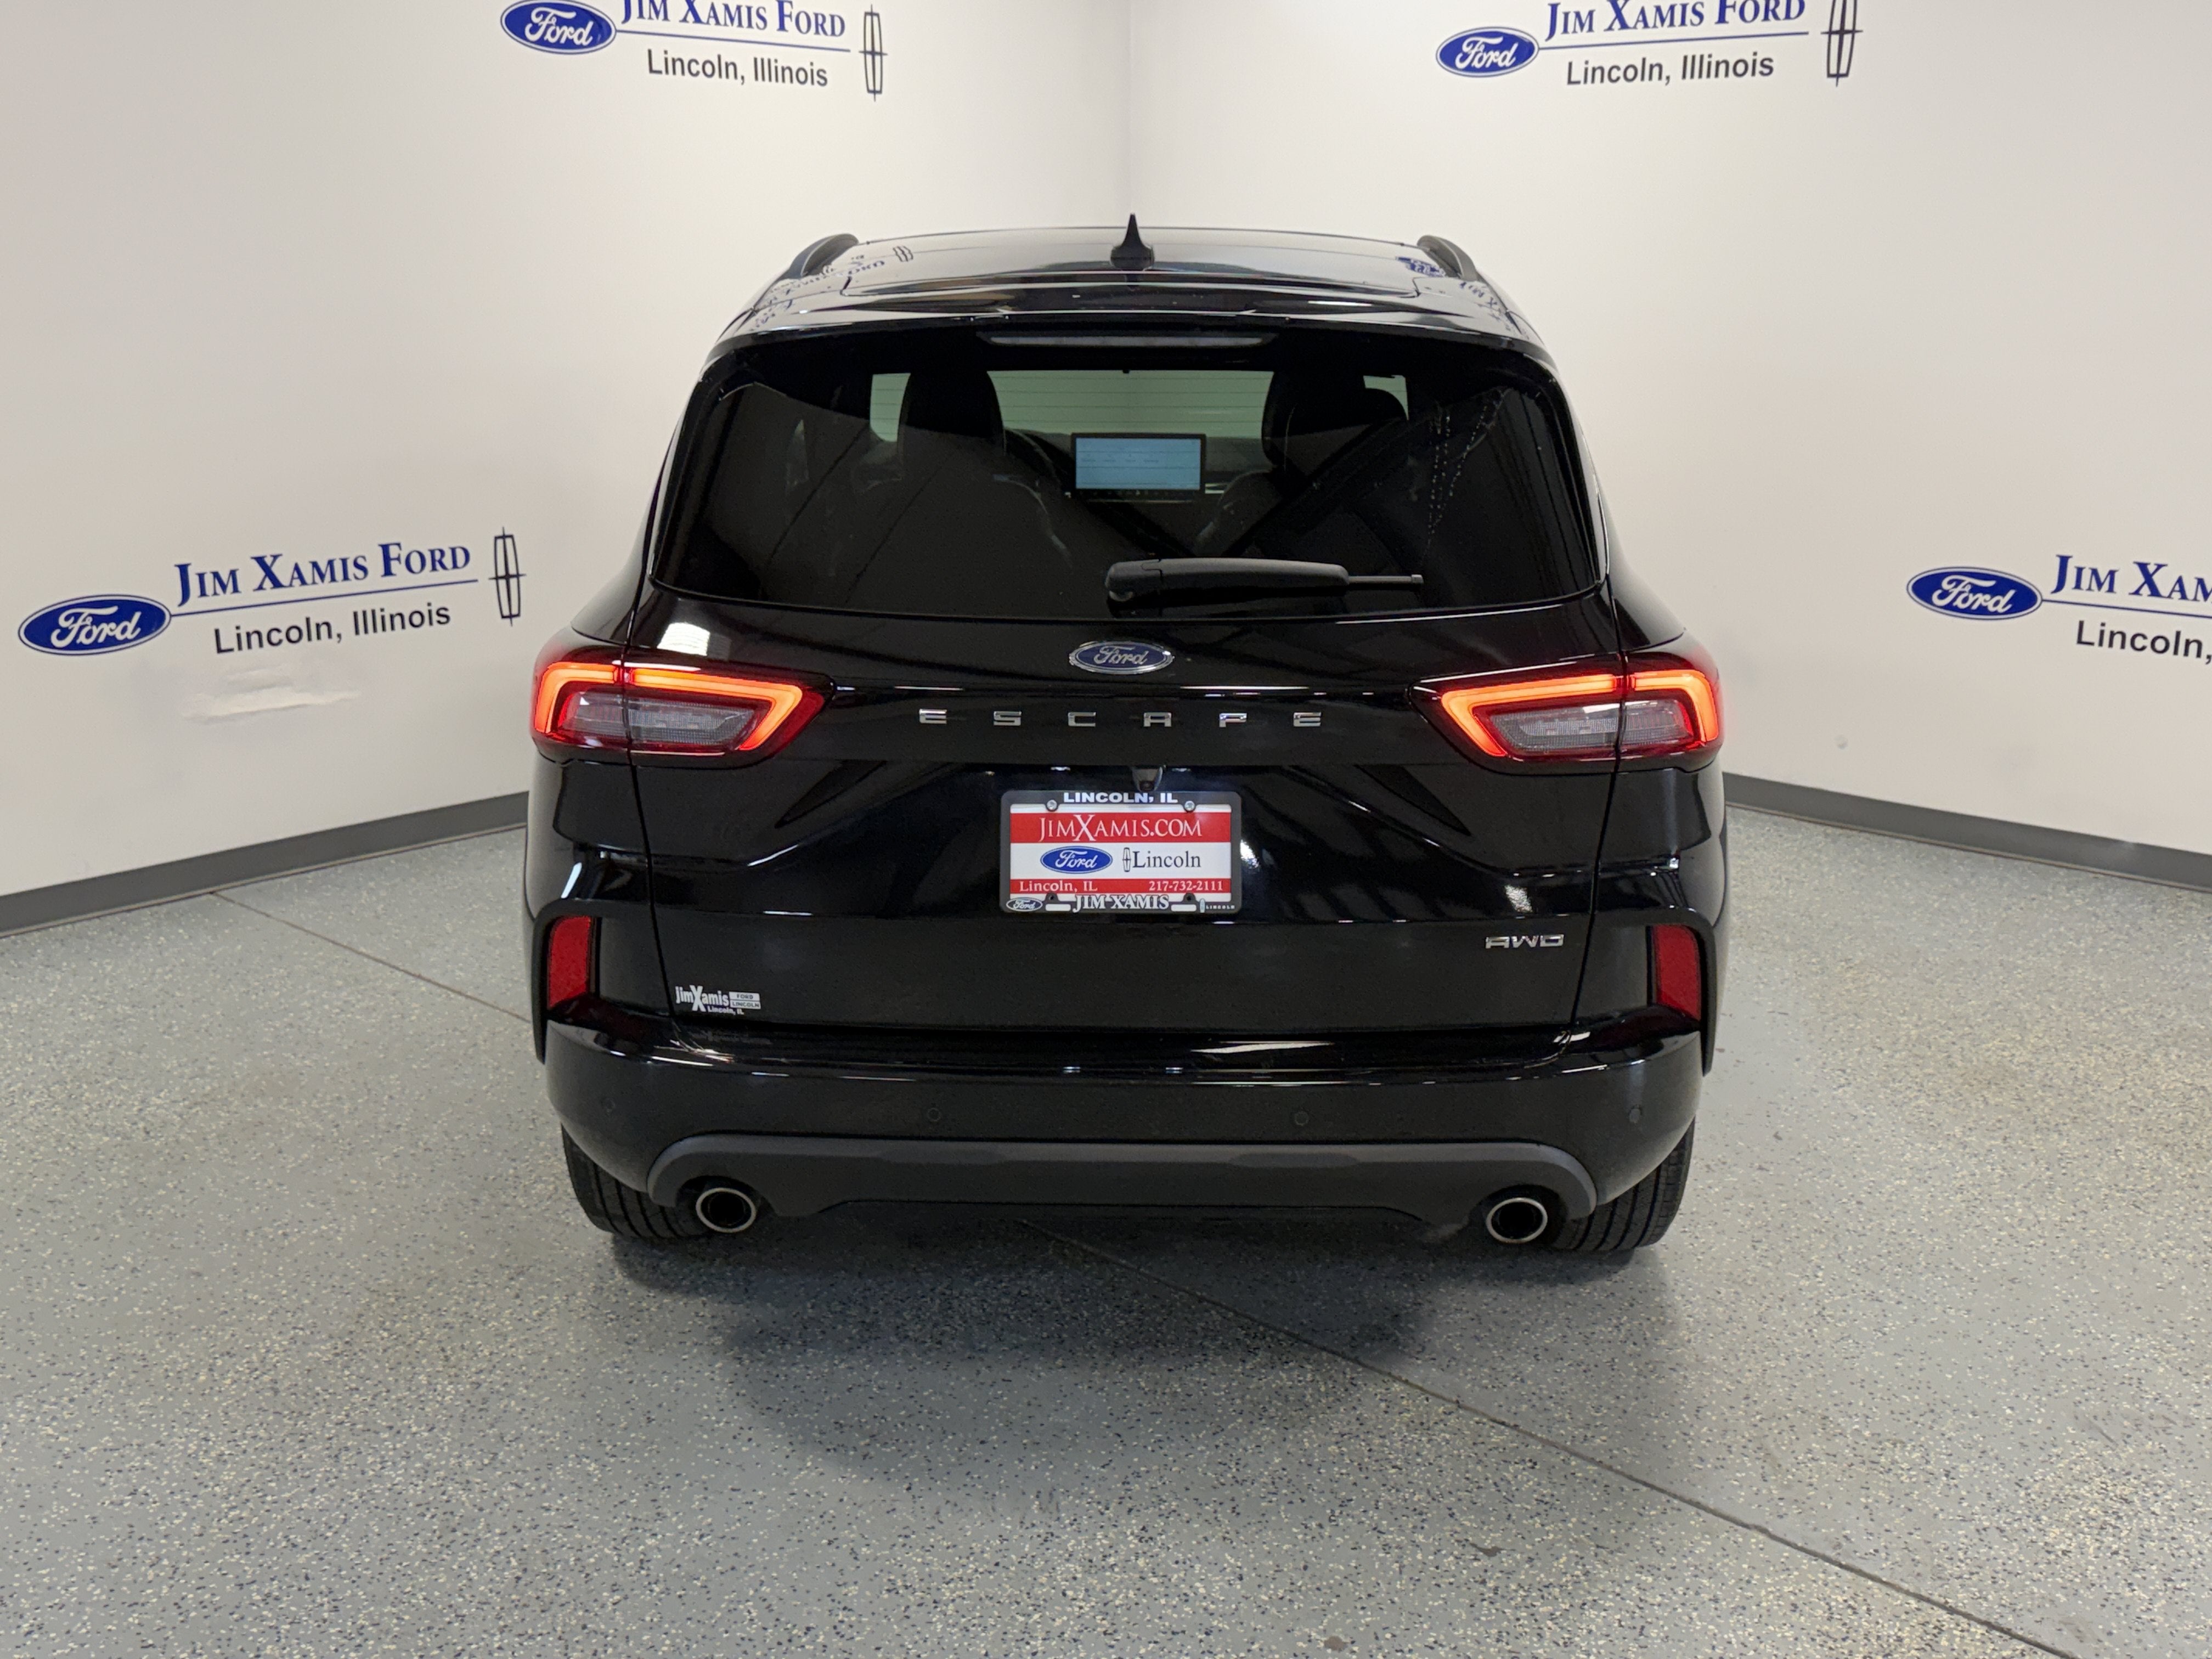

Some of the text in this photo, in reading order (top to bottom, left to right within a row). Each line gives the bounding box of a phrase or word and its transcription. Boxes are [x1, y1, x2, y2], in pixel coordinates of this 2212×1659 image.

[524, 7, 594, 46] Ford
[679, 0, 768, 31] XAMIS
[775, 0, 845, 37] FORD
[1545, 0, 1805, 42] JIM XAMIS FORD
[647, 49, 828, 87] Lincoln, Illinois
[1455, 36, 1516, 70] Ford
[1566, 53, 1775, 86] Lincoln, Illinois
[174, 543, 471, 607] JIM XAMIS FORD
[2050, 554, 2119, 594] JIM
[1931, 574, 2017, 614] Ford
[50, 605, 141, 647] Ford
[213, 602, 452, 654] Lincoln, Illinois
[2076, 620, 2212, 665] Lincoln,
[1093, 645, 1149, 668] Ford
[919, 708, 1322, 728] ESCAPE
[1063, 792, 1178, 804] LINCOLN, IL
[1039, 814, 1203, 842] JIMXAMIS.COM
[1054, 849, 1098, 869] Ford
[1132, 851, 1201, 868] Lincoln
[1019, 880, 1098, 893] Lincoln, IL
[1148, 881, 1223, 891] 217-732-2111
[1012, 899, 1036, 910] Ford
[1073, 894, 1170, 913] JIM XAMIS
[1485, 934, 1564, 949] AWD
